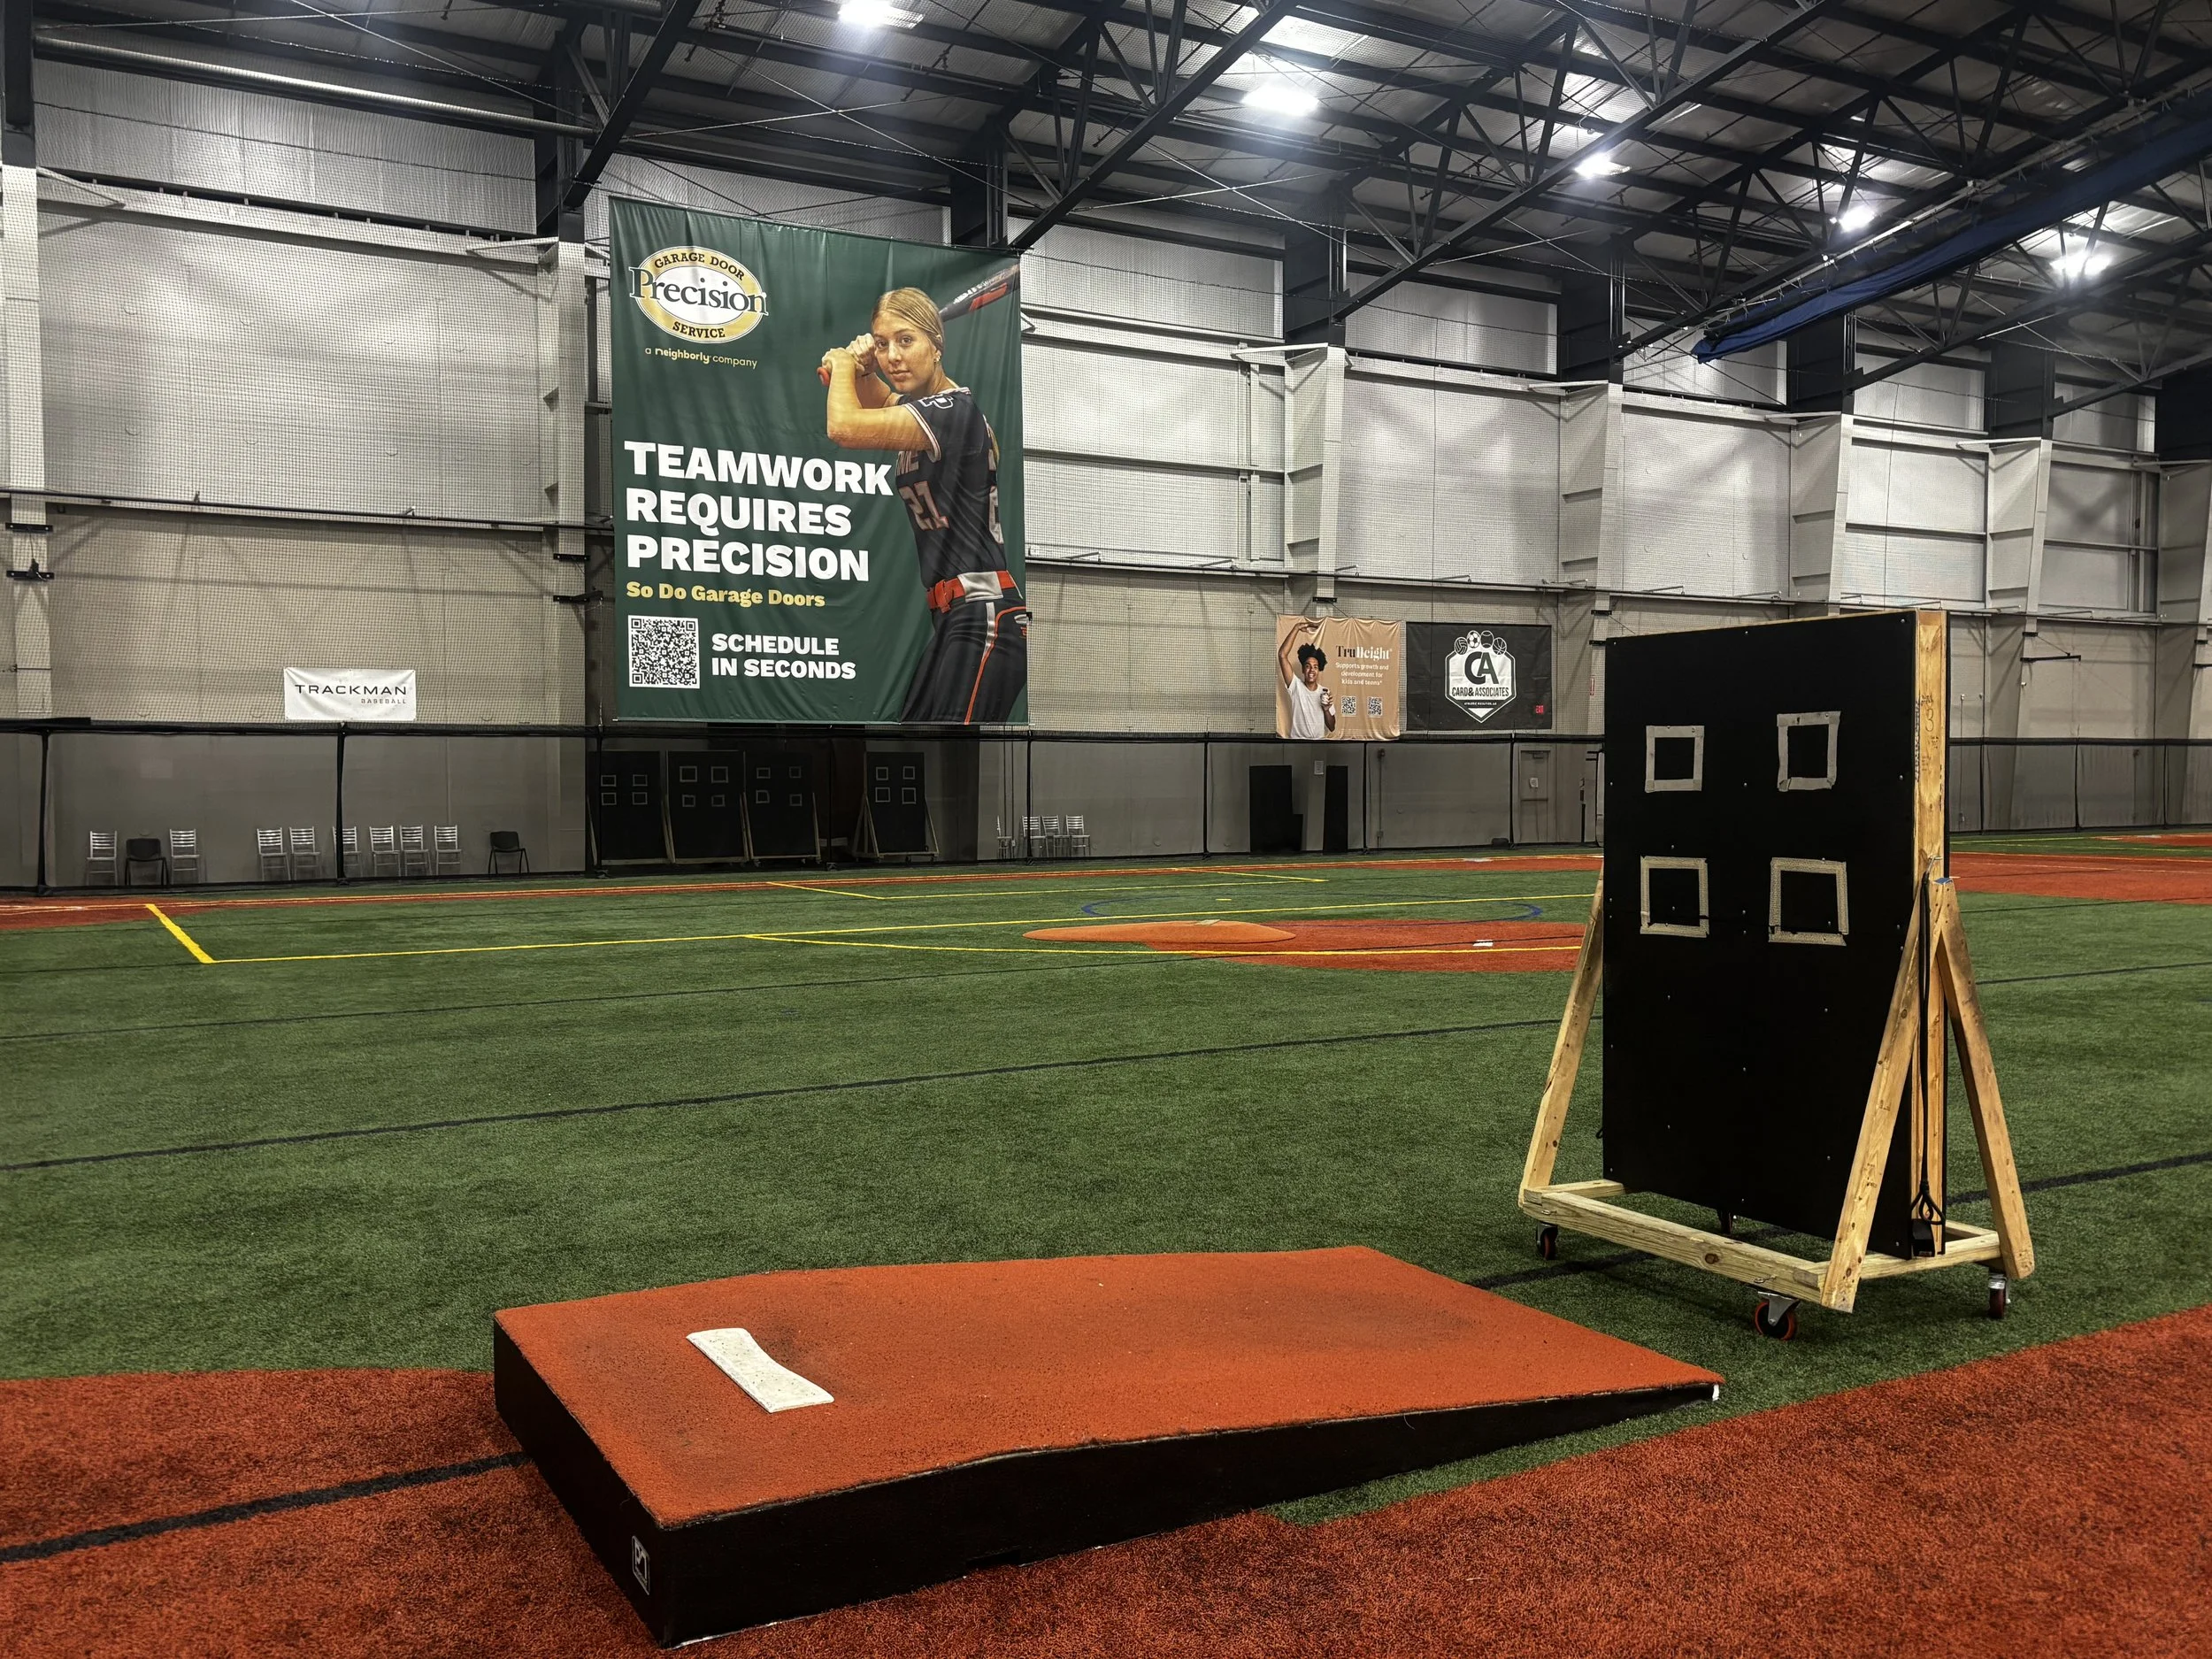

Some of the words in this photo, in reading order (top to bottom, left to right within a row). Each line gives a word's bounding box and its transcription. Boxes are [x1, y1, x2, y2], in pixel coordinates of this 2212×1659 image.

[655, 252, 705, 268] GARAGE
[710, 256, 745, 280] DOOR
[629, 267, 768, 315] Precision
[672, 321, 726, 338] SERVICE
[655, 348, 710, 364] neighborly
[712, 355, 757, 369] company
[624, 441, 894, 496] TEAMWORK
[626, 488, 851, 536] REQUIRES
[627, 534, 869, 582] PRECISION
[626, 581, 653, 598] So
[658, 583, 687, 600] Do
[691, 586, 763, 608] Garage
[768, 589, 826, 607] Doors
[711, 634, 840, 656] SCHEDULE
[711, 657, 737, 676] IN
[743, 659, 856, 680] SECONDS
[1464, 651, 1499, 685] CA
[295, 684, 406, 695] TRACKMAN
[1475, 687, 1509, 696] ASSOCIATES
[1925, 708, 1934, 732] 3
